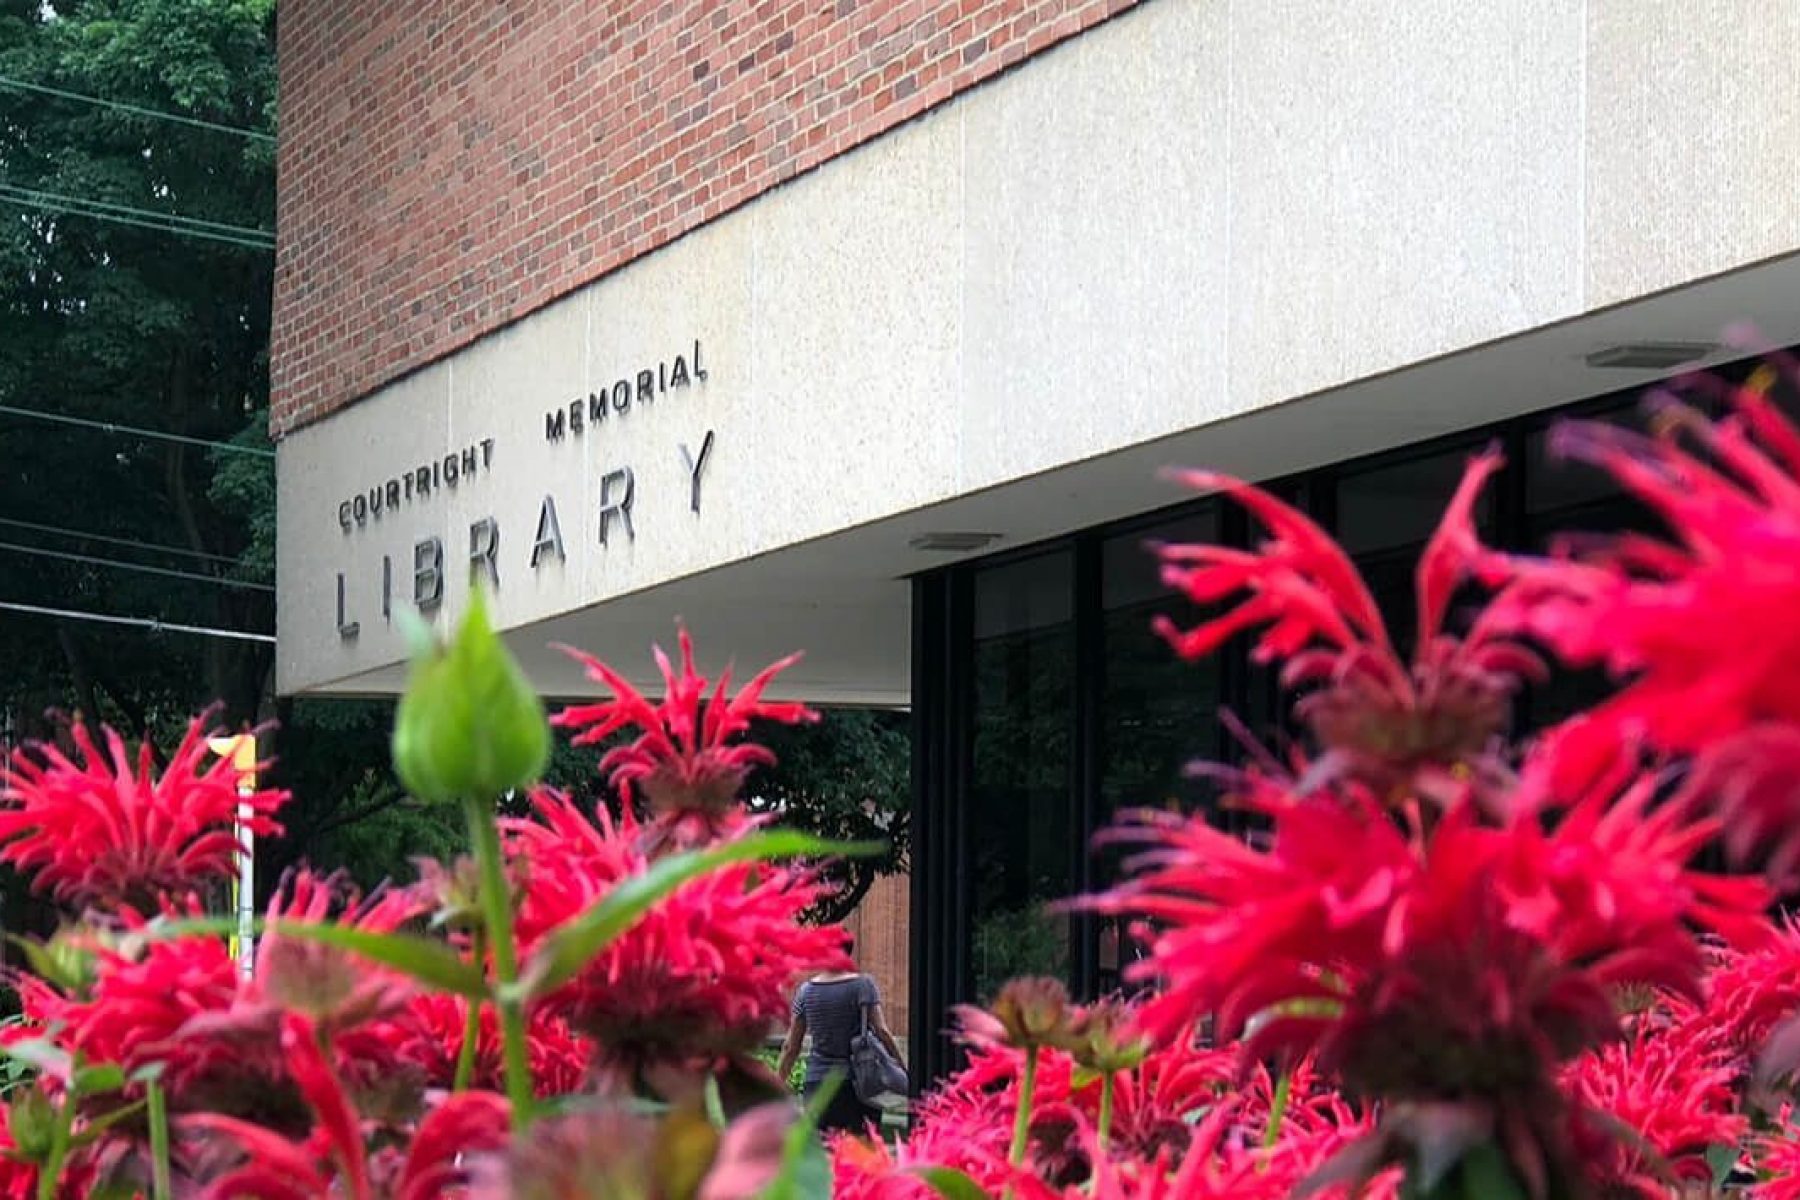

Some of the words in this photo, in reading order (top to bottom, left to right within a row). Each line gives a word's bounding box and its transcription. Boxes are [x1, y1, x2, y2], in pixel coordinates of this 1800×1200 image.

[337, 430, 714, 636] LIBRARY
[339, 439, 495, 530] COURTRIGHT
[545, 339, 707, 441] MEMORIAL
